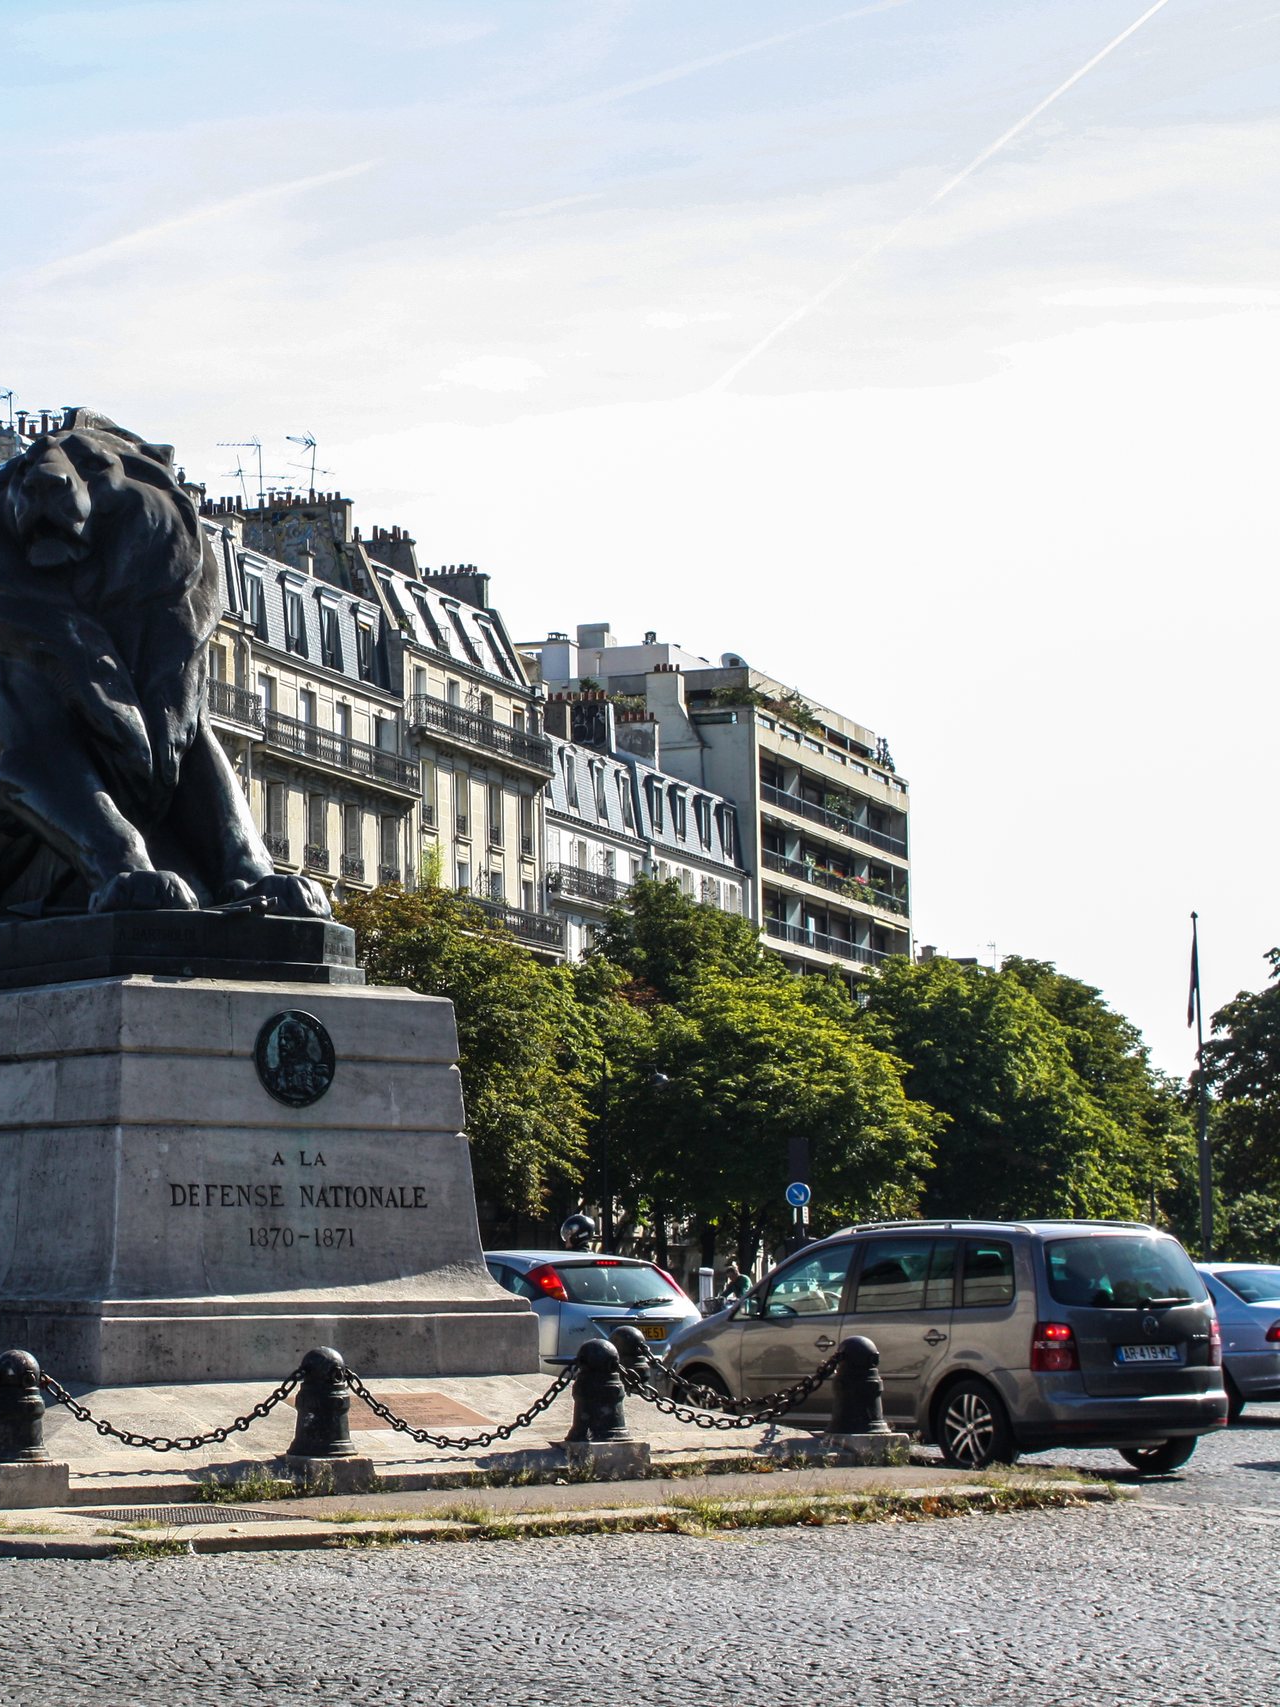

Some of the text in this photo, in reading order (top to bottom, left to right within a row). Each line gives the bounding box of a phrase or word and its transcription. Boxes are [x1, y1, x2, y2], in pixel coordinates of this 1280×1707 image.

[271, 1150, 327, 1167] A LA
[169, 1183, 428, 1209] DEFENSE NATIONALE
